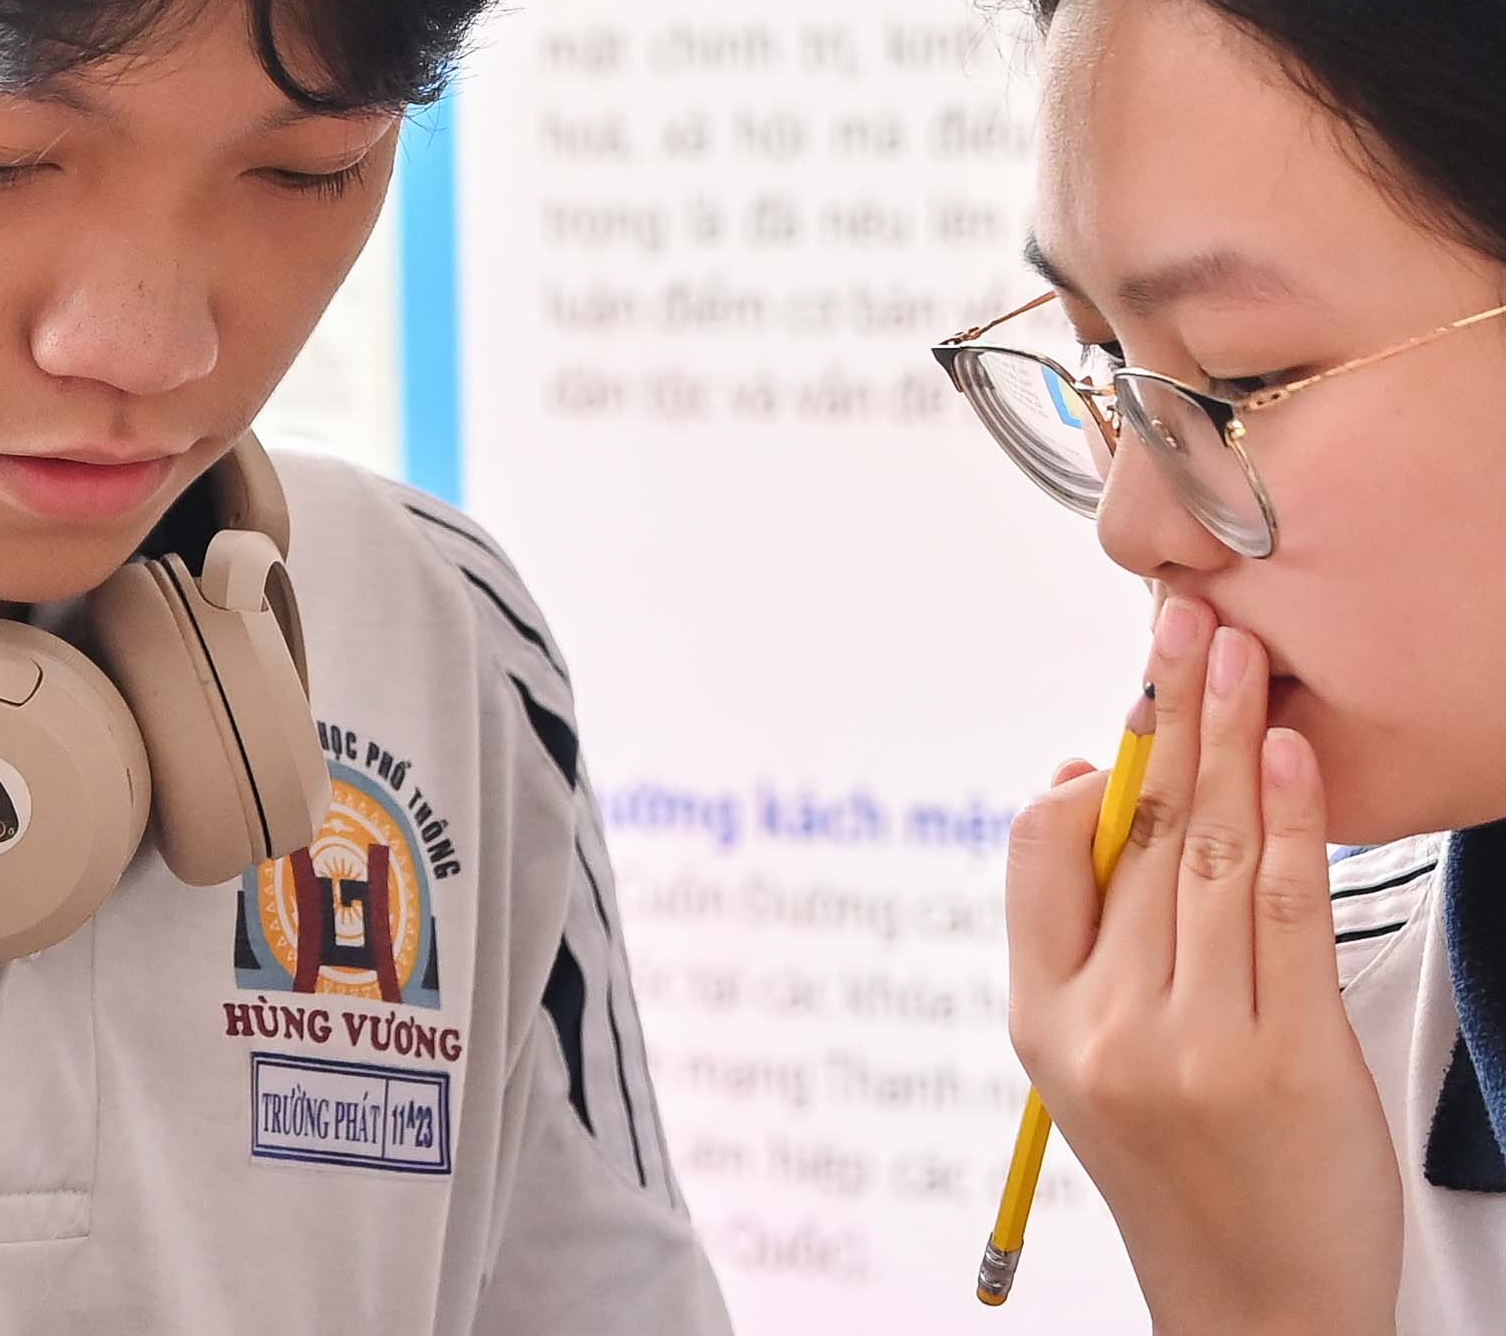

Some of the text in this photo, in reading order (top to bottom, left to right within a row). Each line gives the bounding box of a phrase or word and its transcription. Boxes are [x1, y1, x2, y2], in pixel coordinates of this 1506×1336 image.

[317, 721, 357, 761] HỌC
[408, 787, 461, 880] THÔNG
[756, 786, 885, 841] kách
[223, 996, 463, 1062] HÙNG VƯƠNG
[262, 1083, 380, 1145] TRƯỜNG PHÁT
